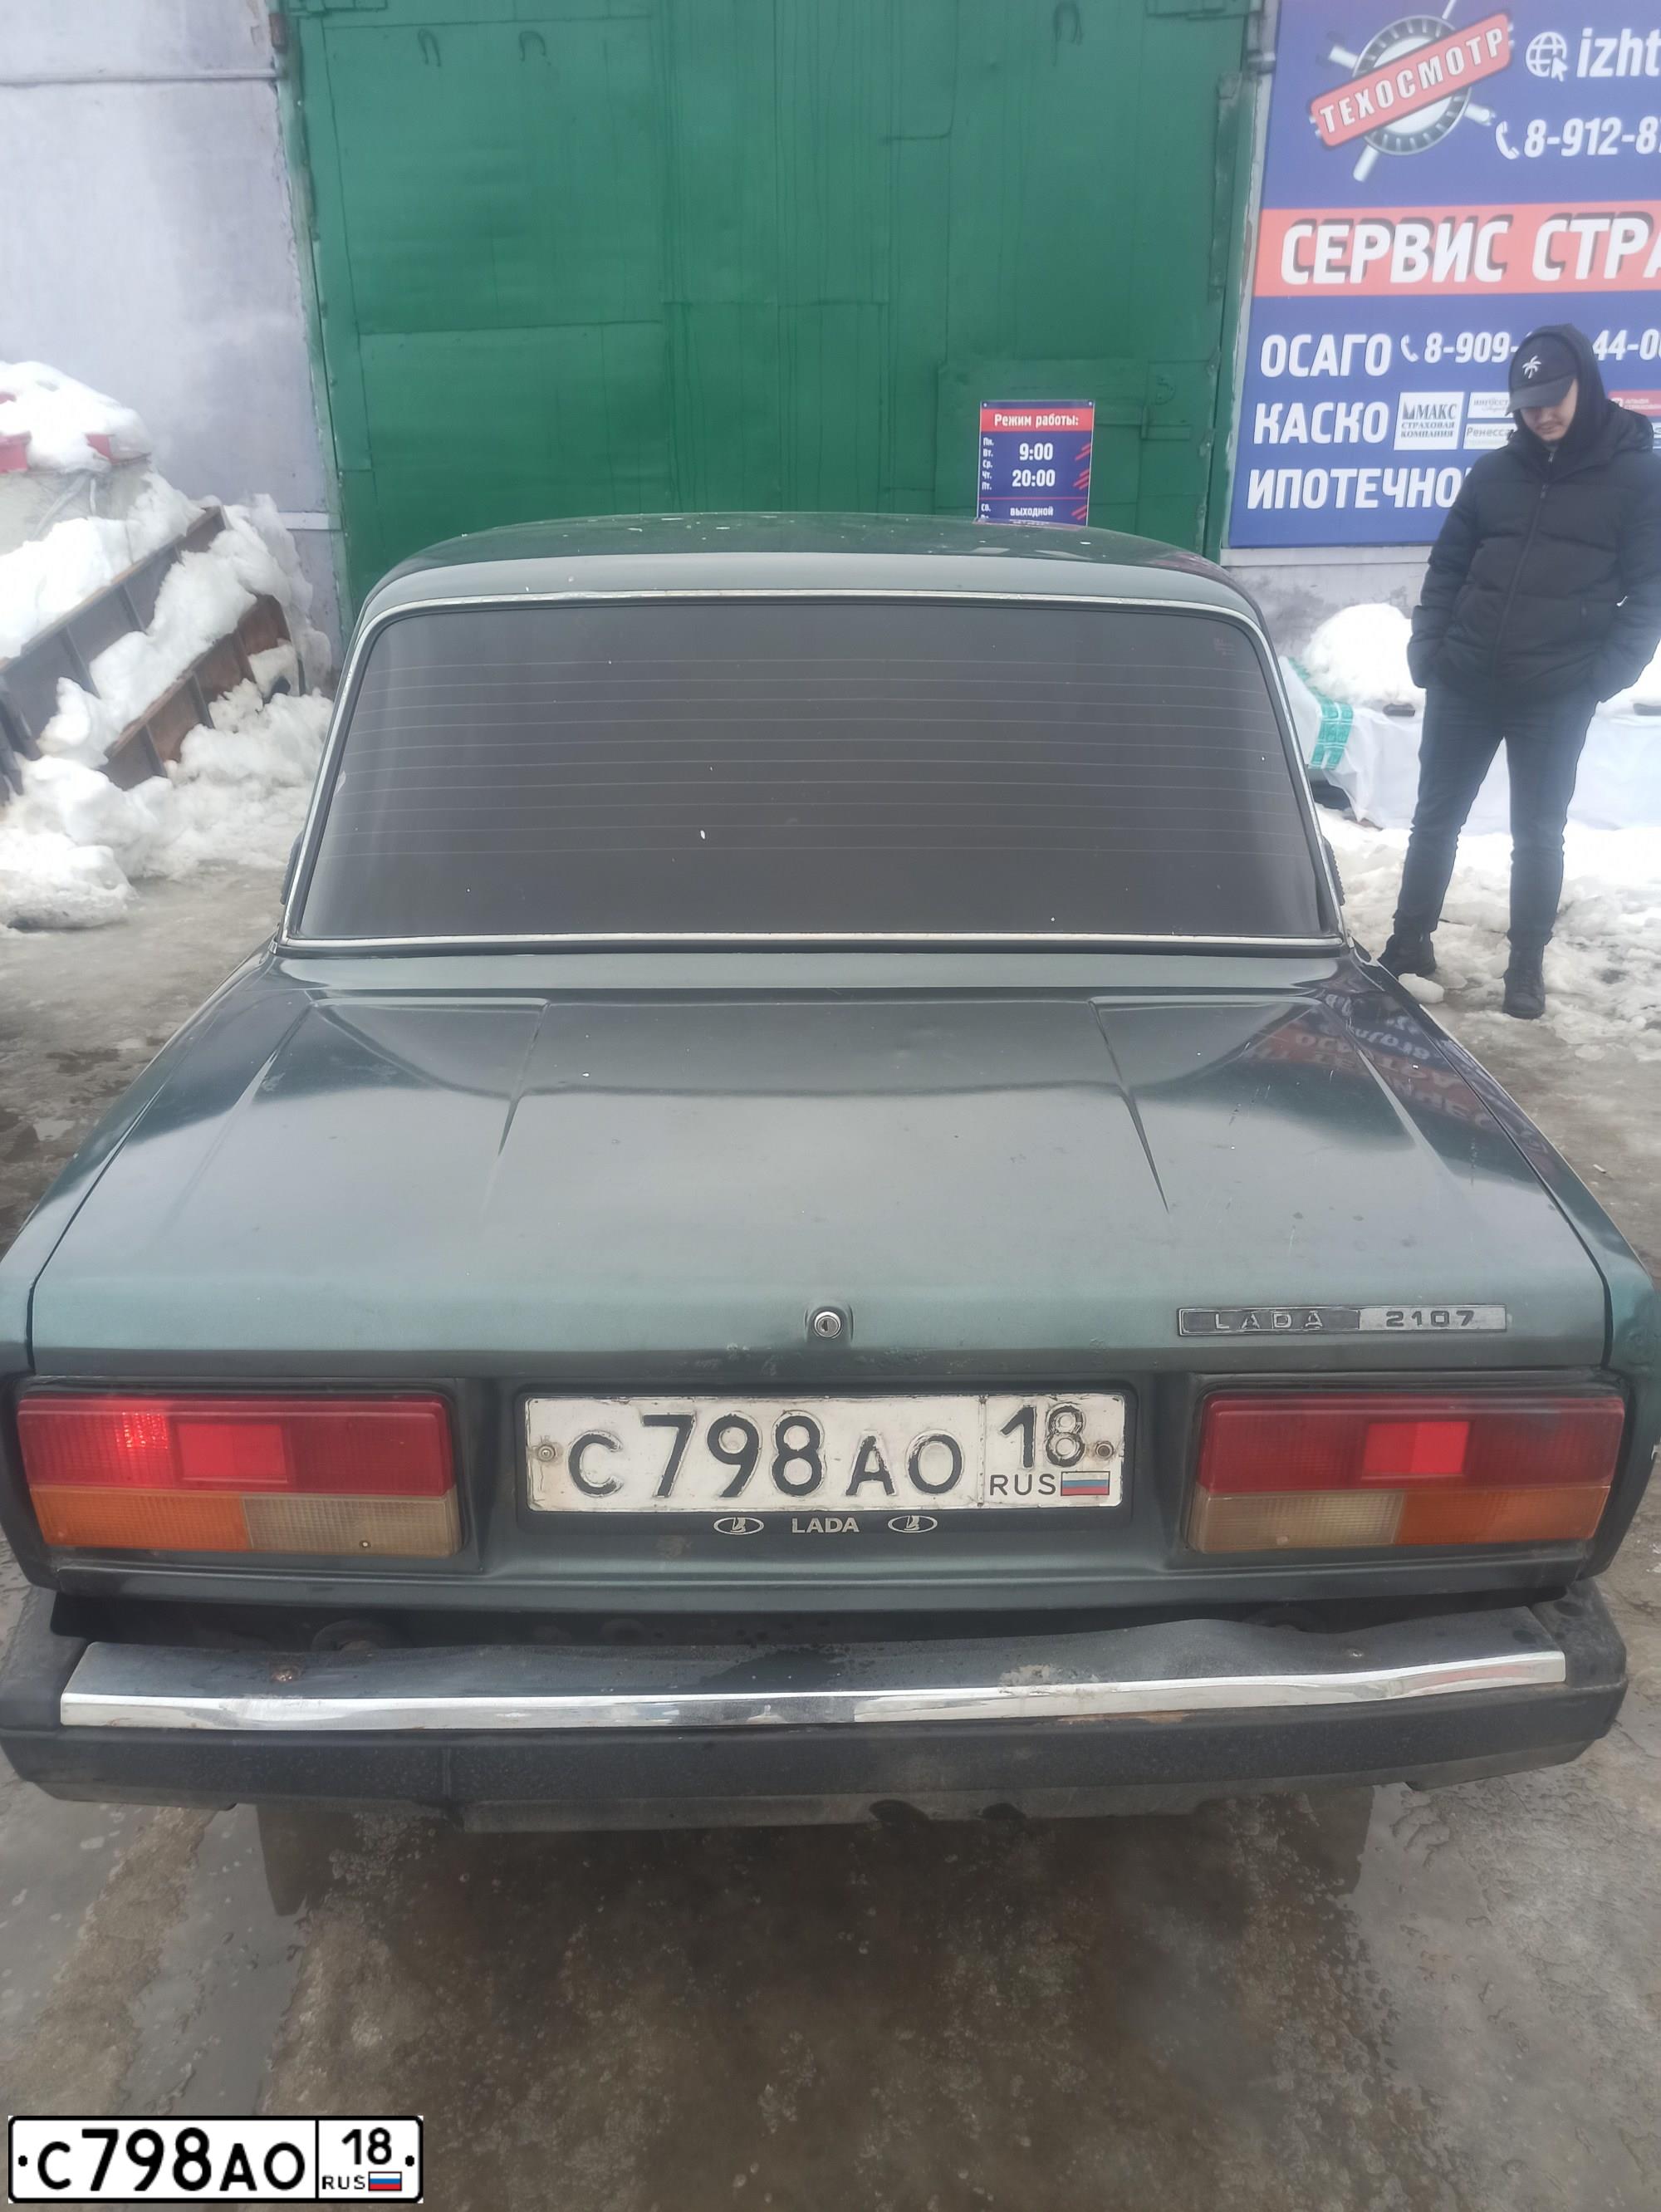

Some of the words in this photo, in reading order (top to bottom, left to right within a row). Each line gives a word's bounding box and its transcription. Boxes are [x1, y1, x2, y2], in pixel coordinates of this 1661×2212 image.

[1320, 27, 1503, 134] ТЕХОСМОТР
[1523, 115, 1661, 159] 8-912-8
[1281, 220, 1510, 285] СЕРВИС
[1259, 333, 1392, 378] ОСАГО
[1592, 329, 1661, 361] 44-0
[994, 413, 1031, 426] Режим
[1036, 414, 1079, 429] работы:
[1252, 401, 1389, 445] КАСКО
[1414, 403, 1457, 420] МАКС
[1400, 429, 1453, 439] КОМПАНИЯ
[1019, 442, 1054, 461] 9:00
[1012, 468, 1056, 488] 20:00
[1247, 467, 1472, 510] ИПОТЕЧНО
[1215, 1311, 1324, 1330] LADA
[1385, 1310, 1476, 1327] 2107
[566, 1410, 964, 1498] С798АО
[999, 1403, 1085, 1469] 18
[990, 1473, 1058, 1497] RUS
[791, 1518, 860, 1534] LADA
